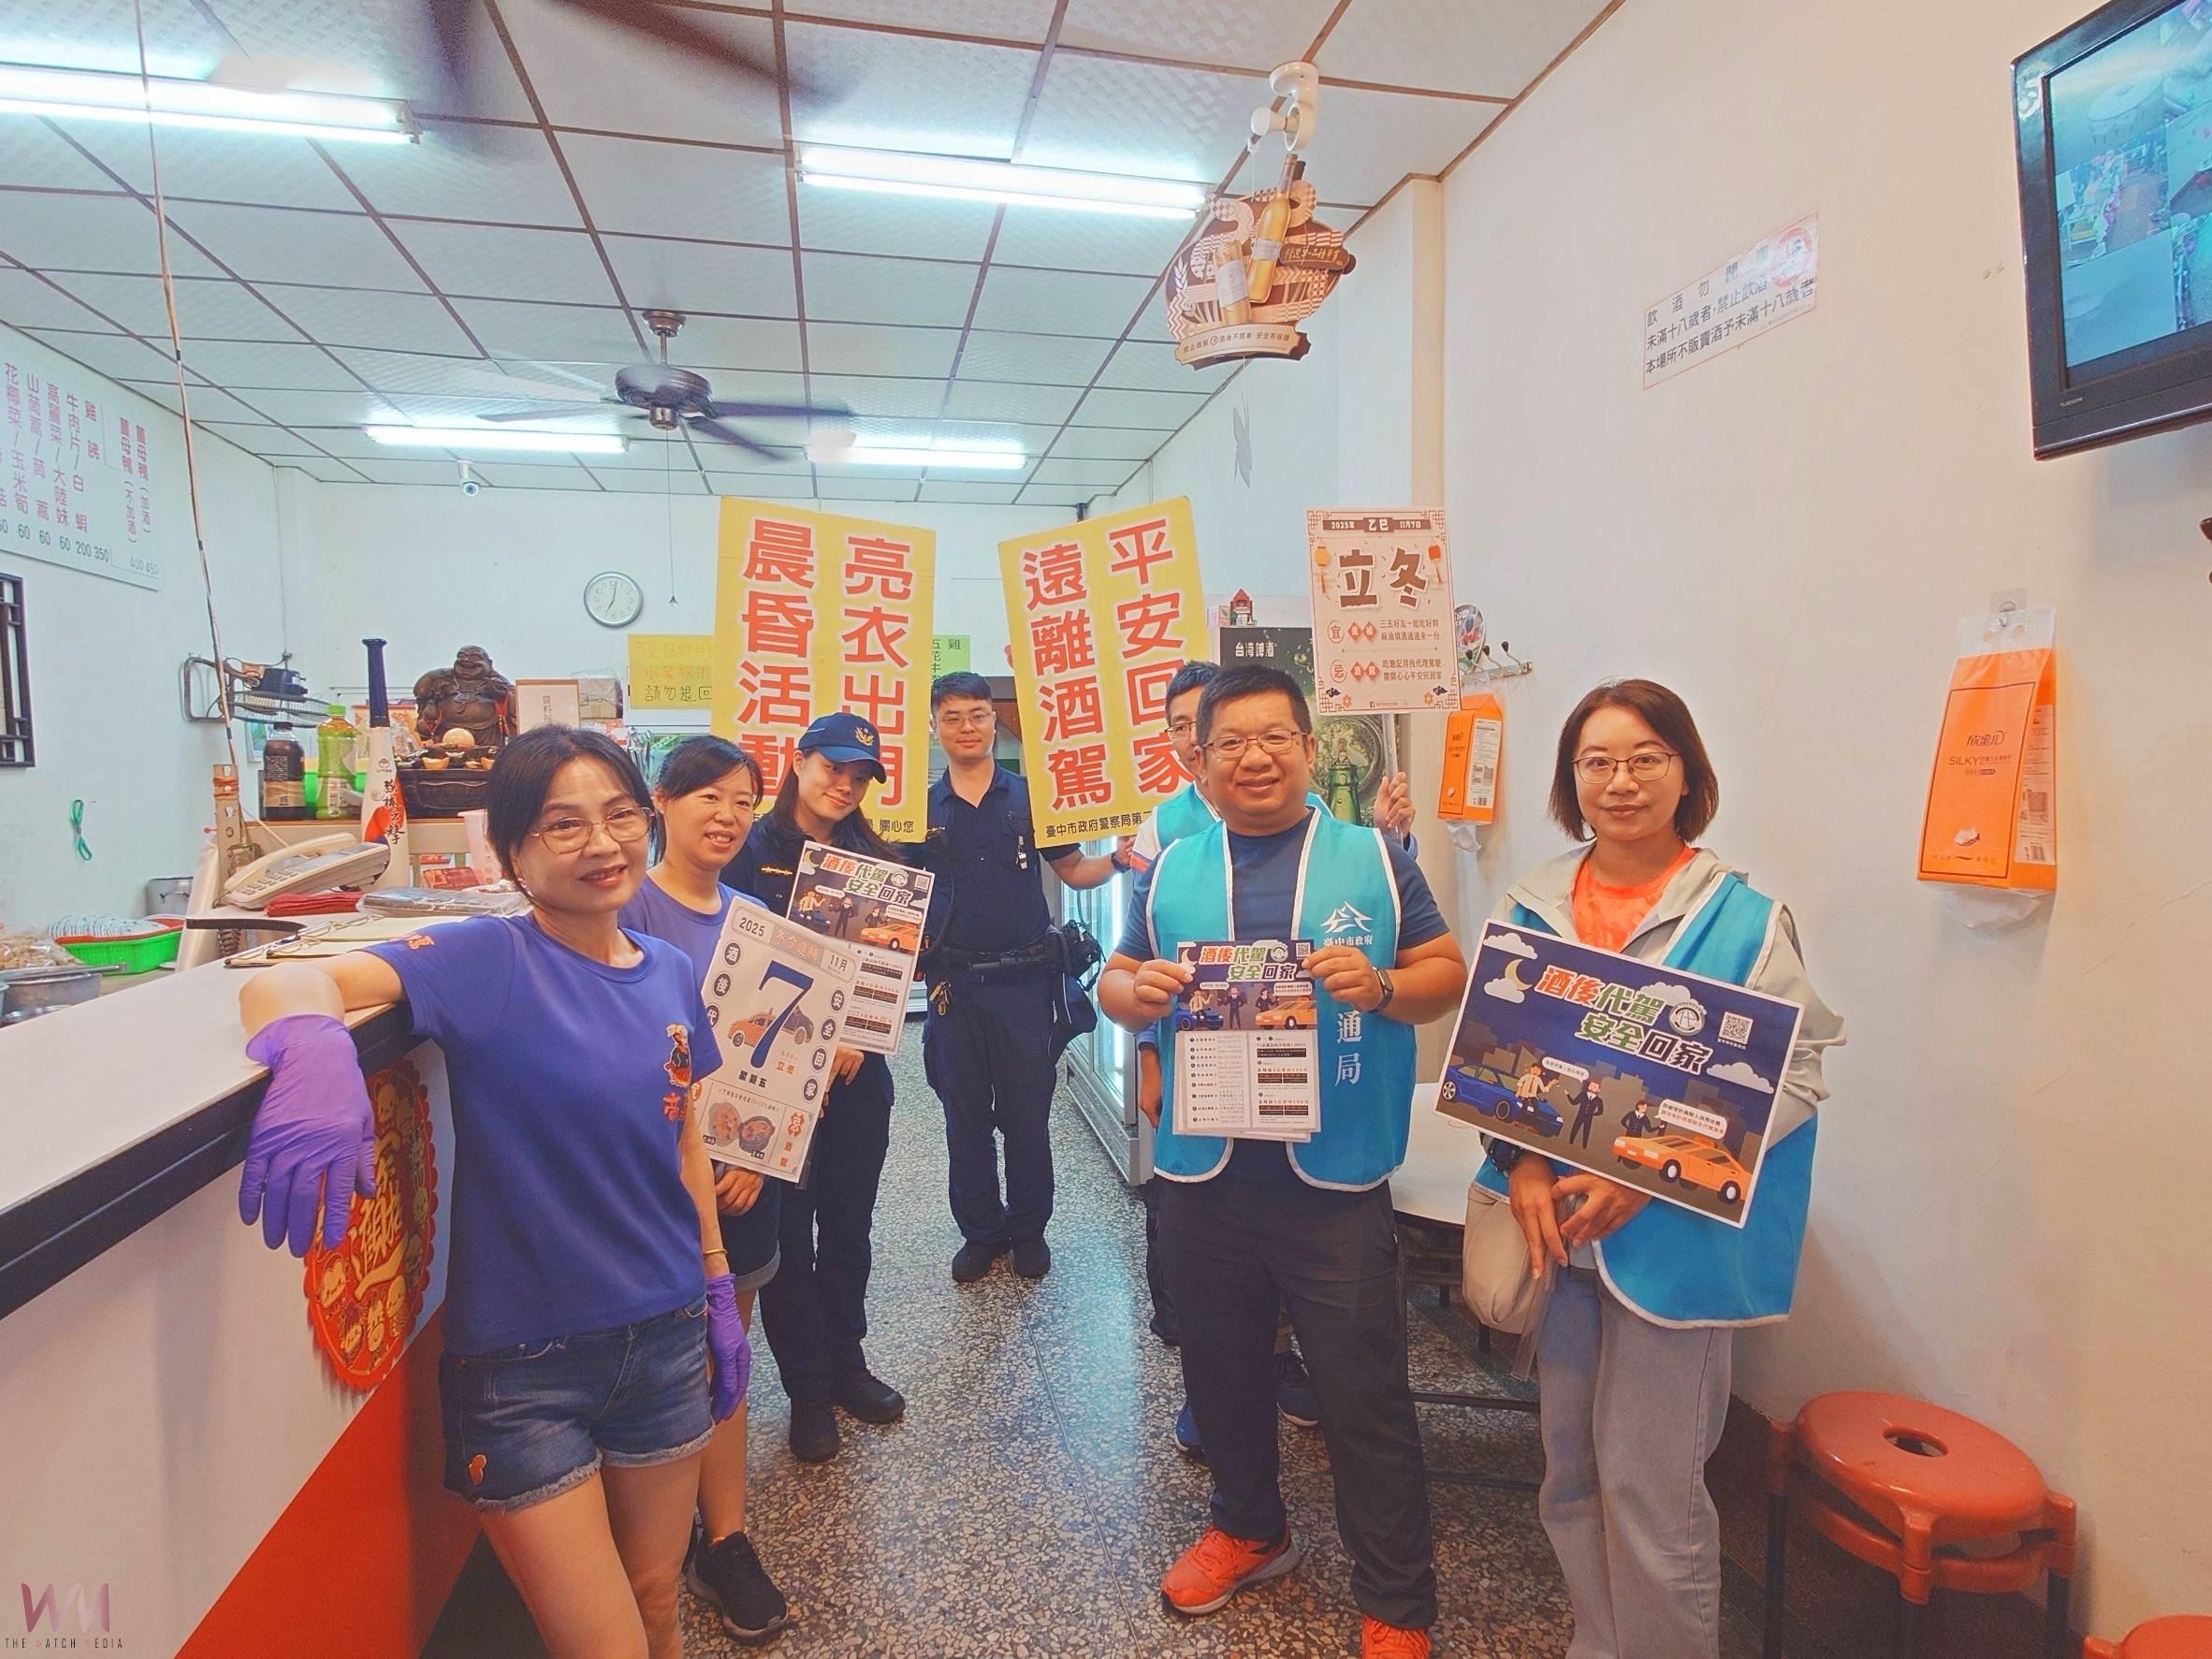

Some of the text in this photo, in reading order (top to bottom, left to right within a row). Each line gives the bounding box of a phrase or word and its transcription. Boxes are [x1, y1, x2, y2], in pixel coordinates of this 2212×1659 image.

[1400, 520, 1421, 529] 11月7日
[19, 524, 30, 540] 60
[39, 530, 51, 546] 60
[59, 535, 71, 551] 60
[76, 541, 92, 558] 200
[94, 546, 109, 562] 350
[1339, 548, 1428, 608] 立冬
[948, 638, 962, 650] 雞
[1331, 625, 1342, 639] 宜
[1022, 543, 1112, 810] 遠離酒駕
[1108, 518, 1194, 812] 平安回家
[1333, 664, 1345, 678] 忌
[1948, 755, 1979, 765] SILKY
[879, 819, 914, 834] 關心您
[822, 852, 890, 884] 酒後代駕
[846, 877, 914, 908] 安全回家
[738, 916, 766, 939] 2025
[829, 954, 849, 973] 11月
[1199, 945, 1268, 966] 酒後代駕
[1228, 963, 1298, 982] 安全回家
[1535, 964, 1668, 1026] 酒後代駕
[759, 959, 815, 1069] 7
[1574, 1011, 1714, 1075] 安全回家
